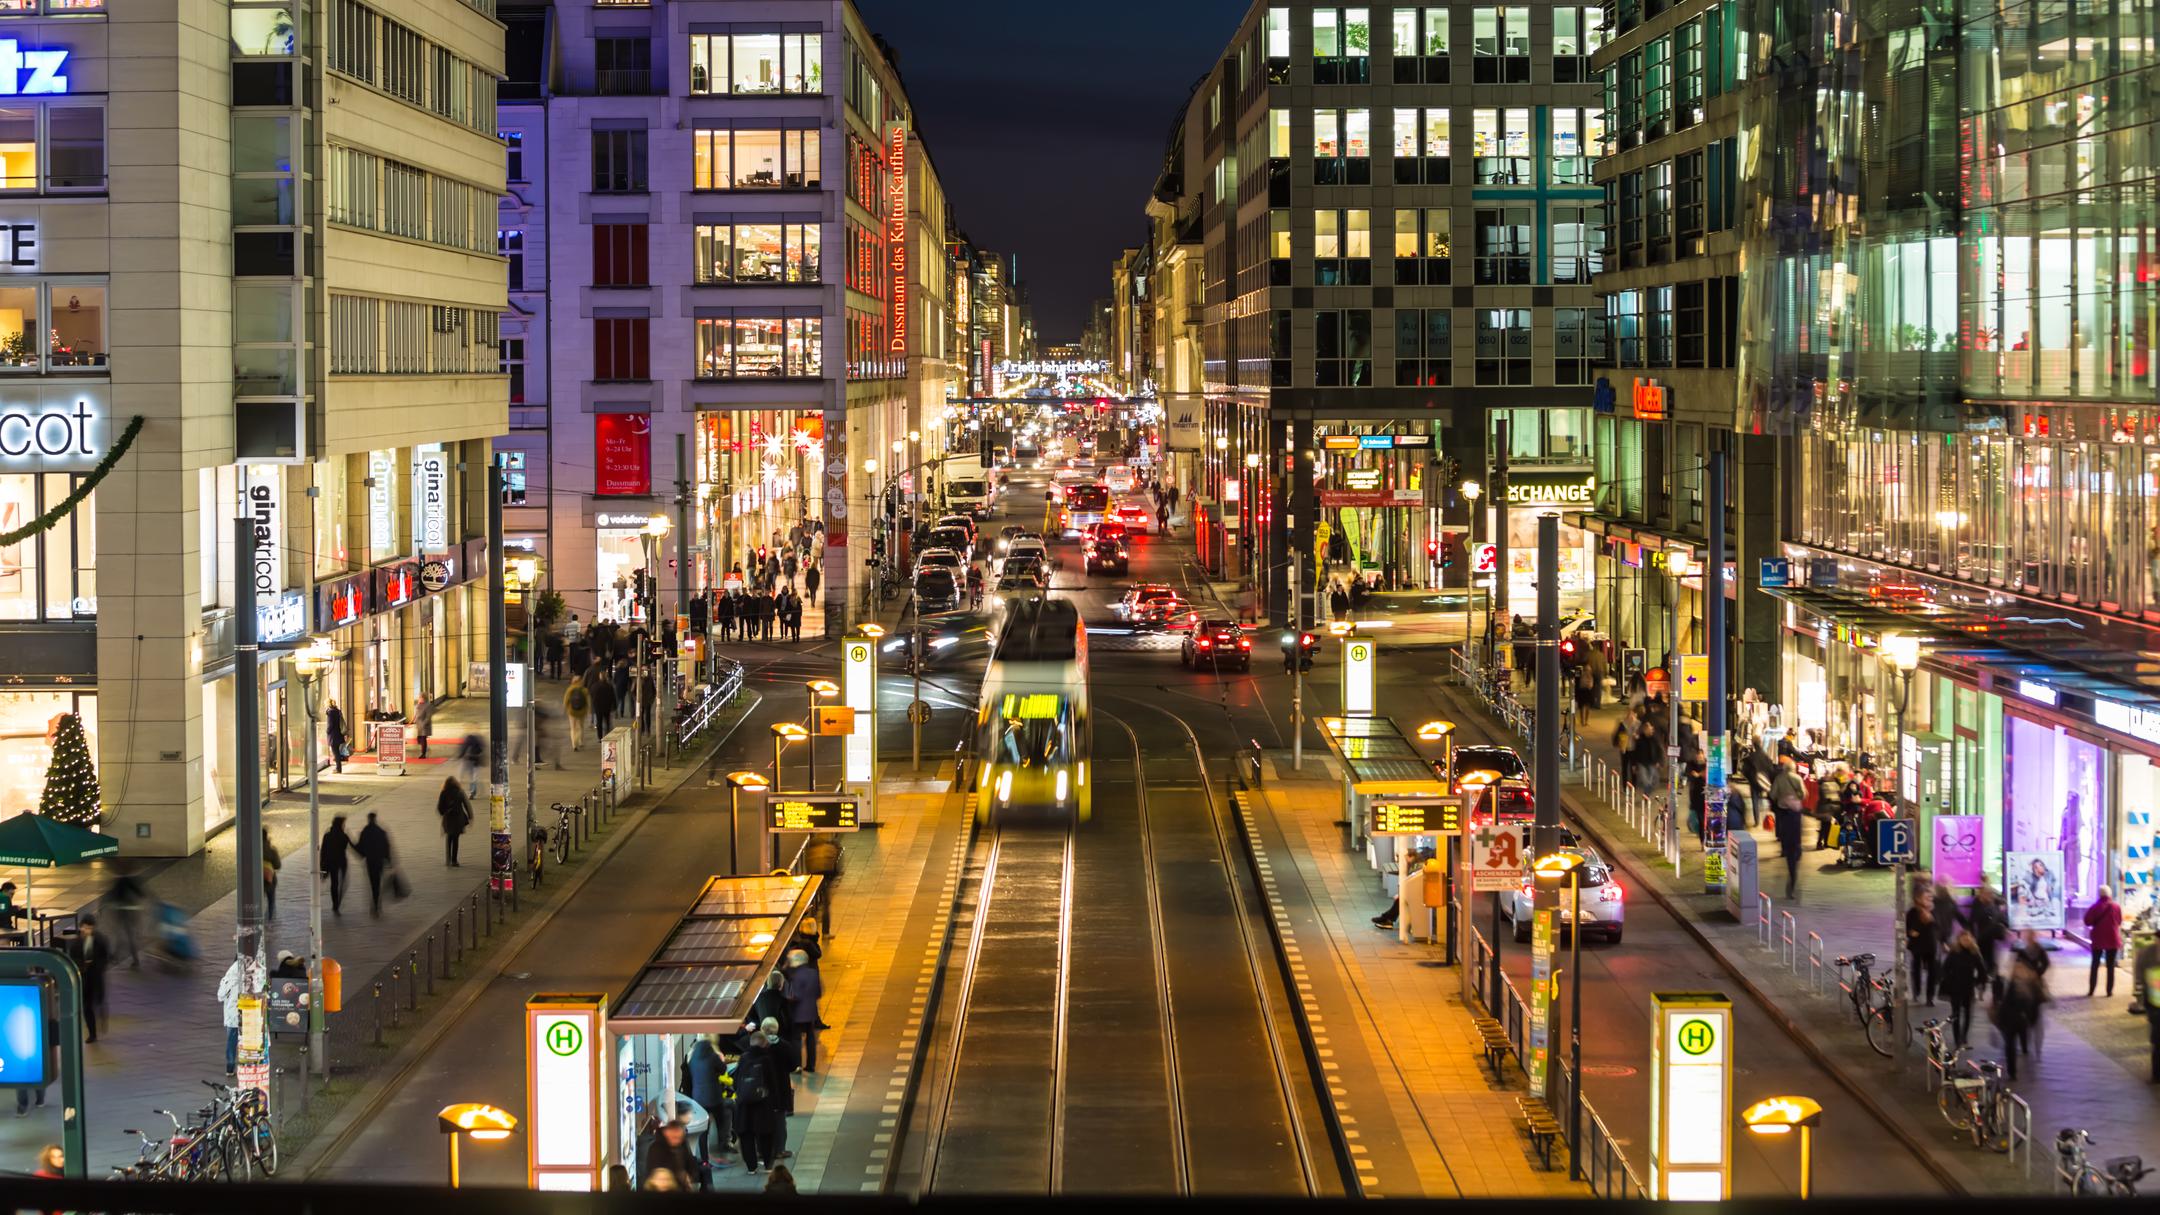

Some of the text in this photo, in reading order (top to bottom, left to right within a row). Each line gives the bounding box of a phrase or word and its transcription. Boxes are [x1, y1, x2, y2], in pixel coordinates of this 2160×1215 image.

[0, 225, 35, 266] E
[890, 127, 905, 351] Dussmann das KulturKaufhaus
[606, 479, 641, 487] Dussmann
[424, 459, 444, 545] ginatricot
[250, 485, 276, 597] ginatricot
[1893, 830, 1907, 853] P
[556, 1029, 573, 1048] H
[1688, 1028, 1704, 1047] H
